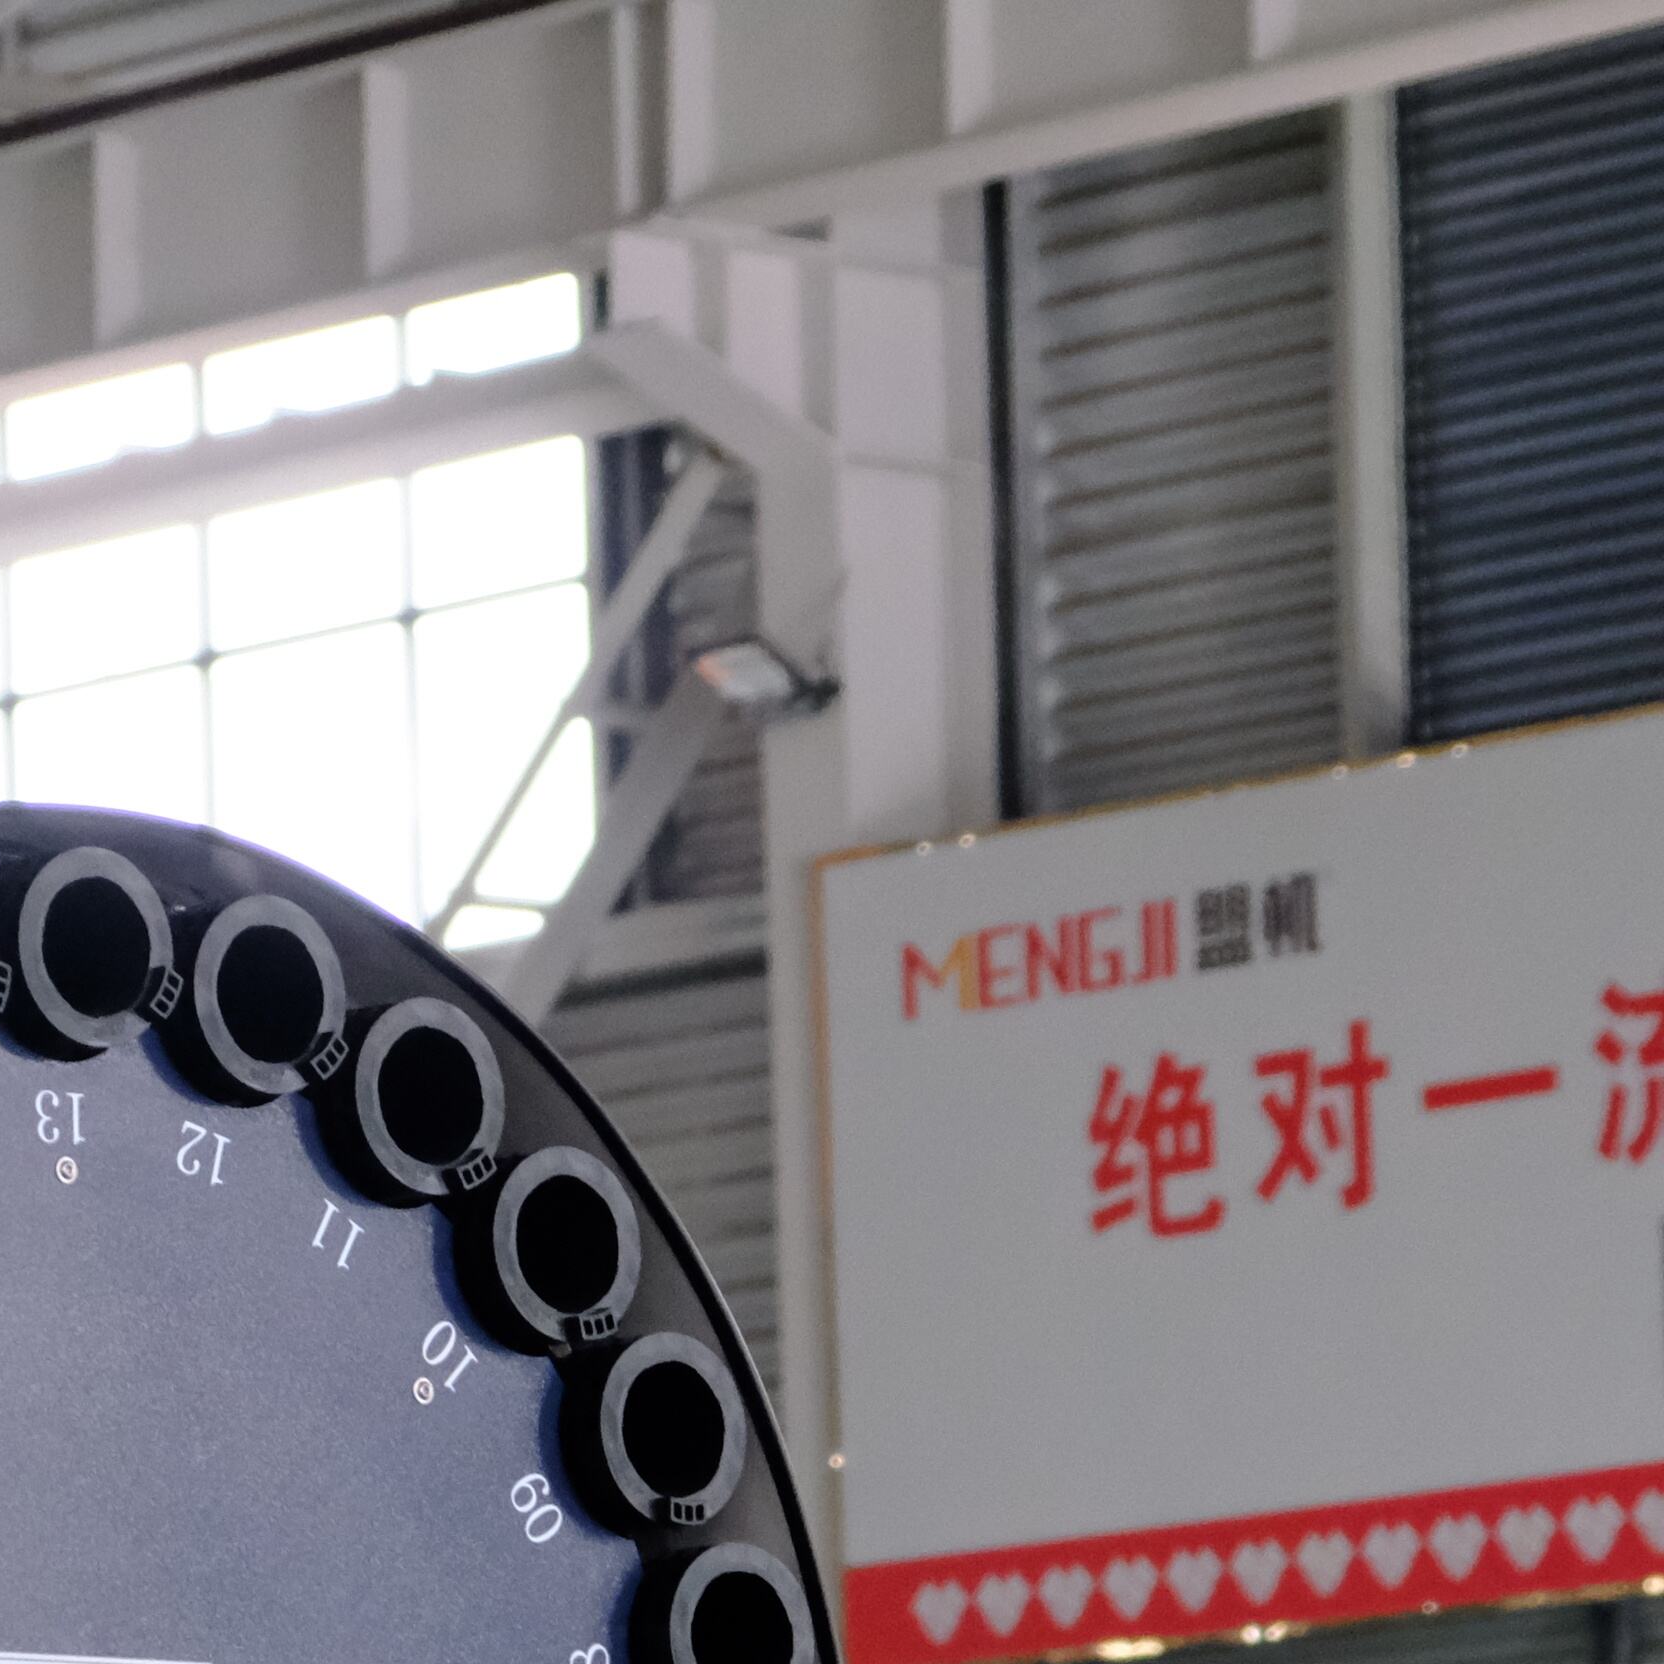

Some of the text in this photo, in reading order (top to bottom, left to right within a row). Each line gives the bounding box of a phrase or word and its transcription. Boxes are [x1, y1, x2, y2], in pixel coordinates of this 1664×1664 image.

[902, 898, 1178, 1020] MENGJI
[35, 1089, 86, 1145] 13
[176, 1120, 231, 1185] 12
[311, 1198, 365, 1270] 11
[422, 1320, 478, 1393] 10
[510, 1473, 562, 1543] 09
